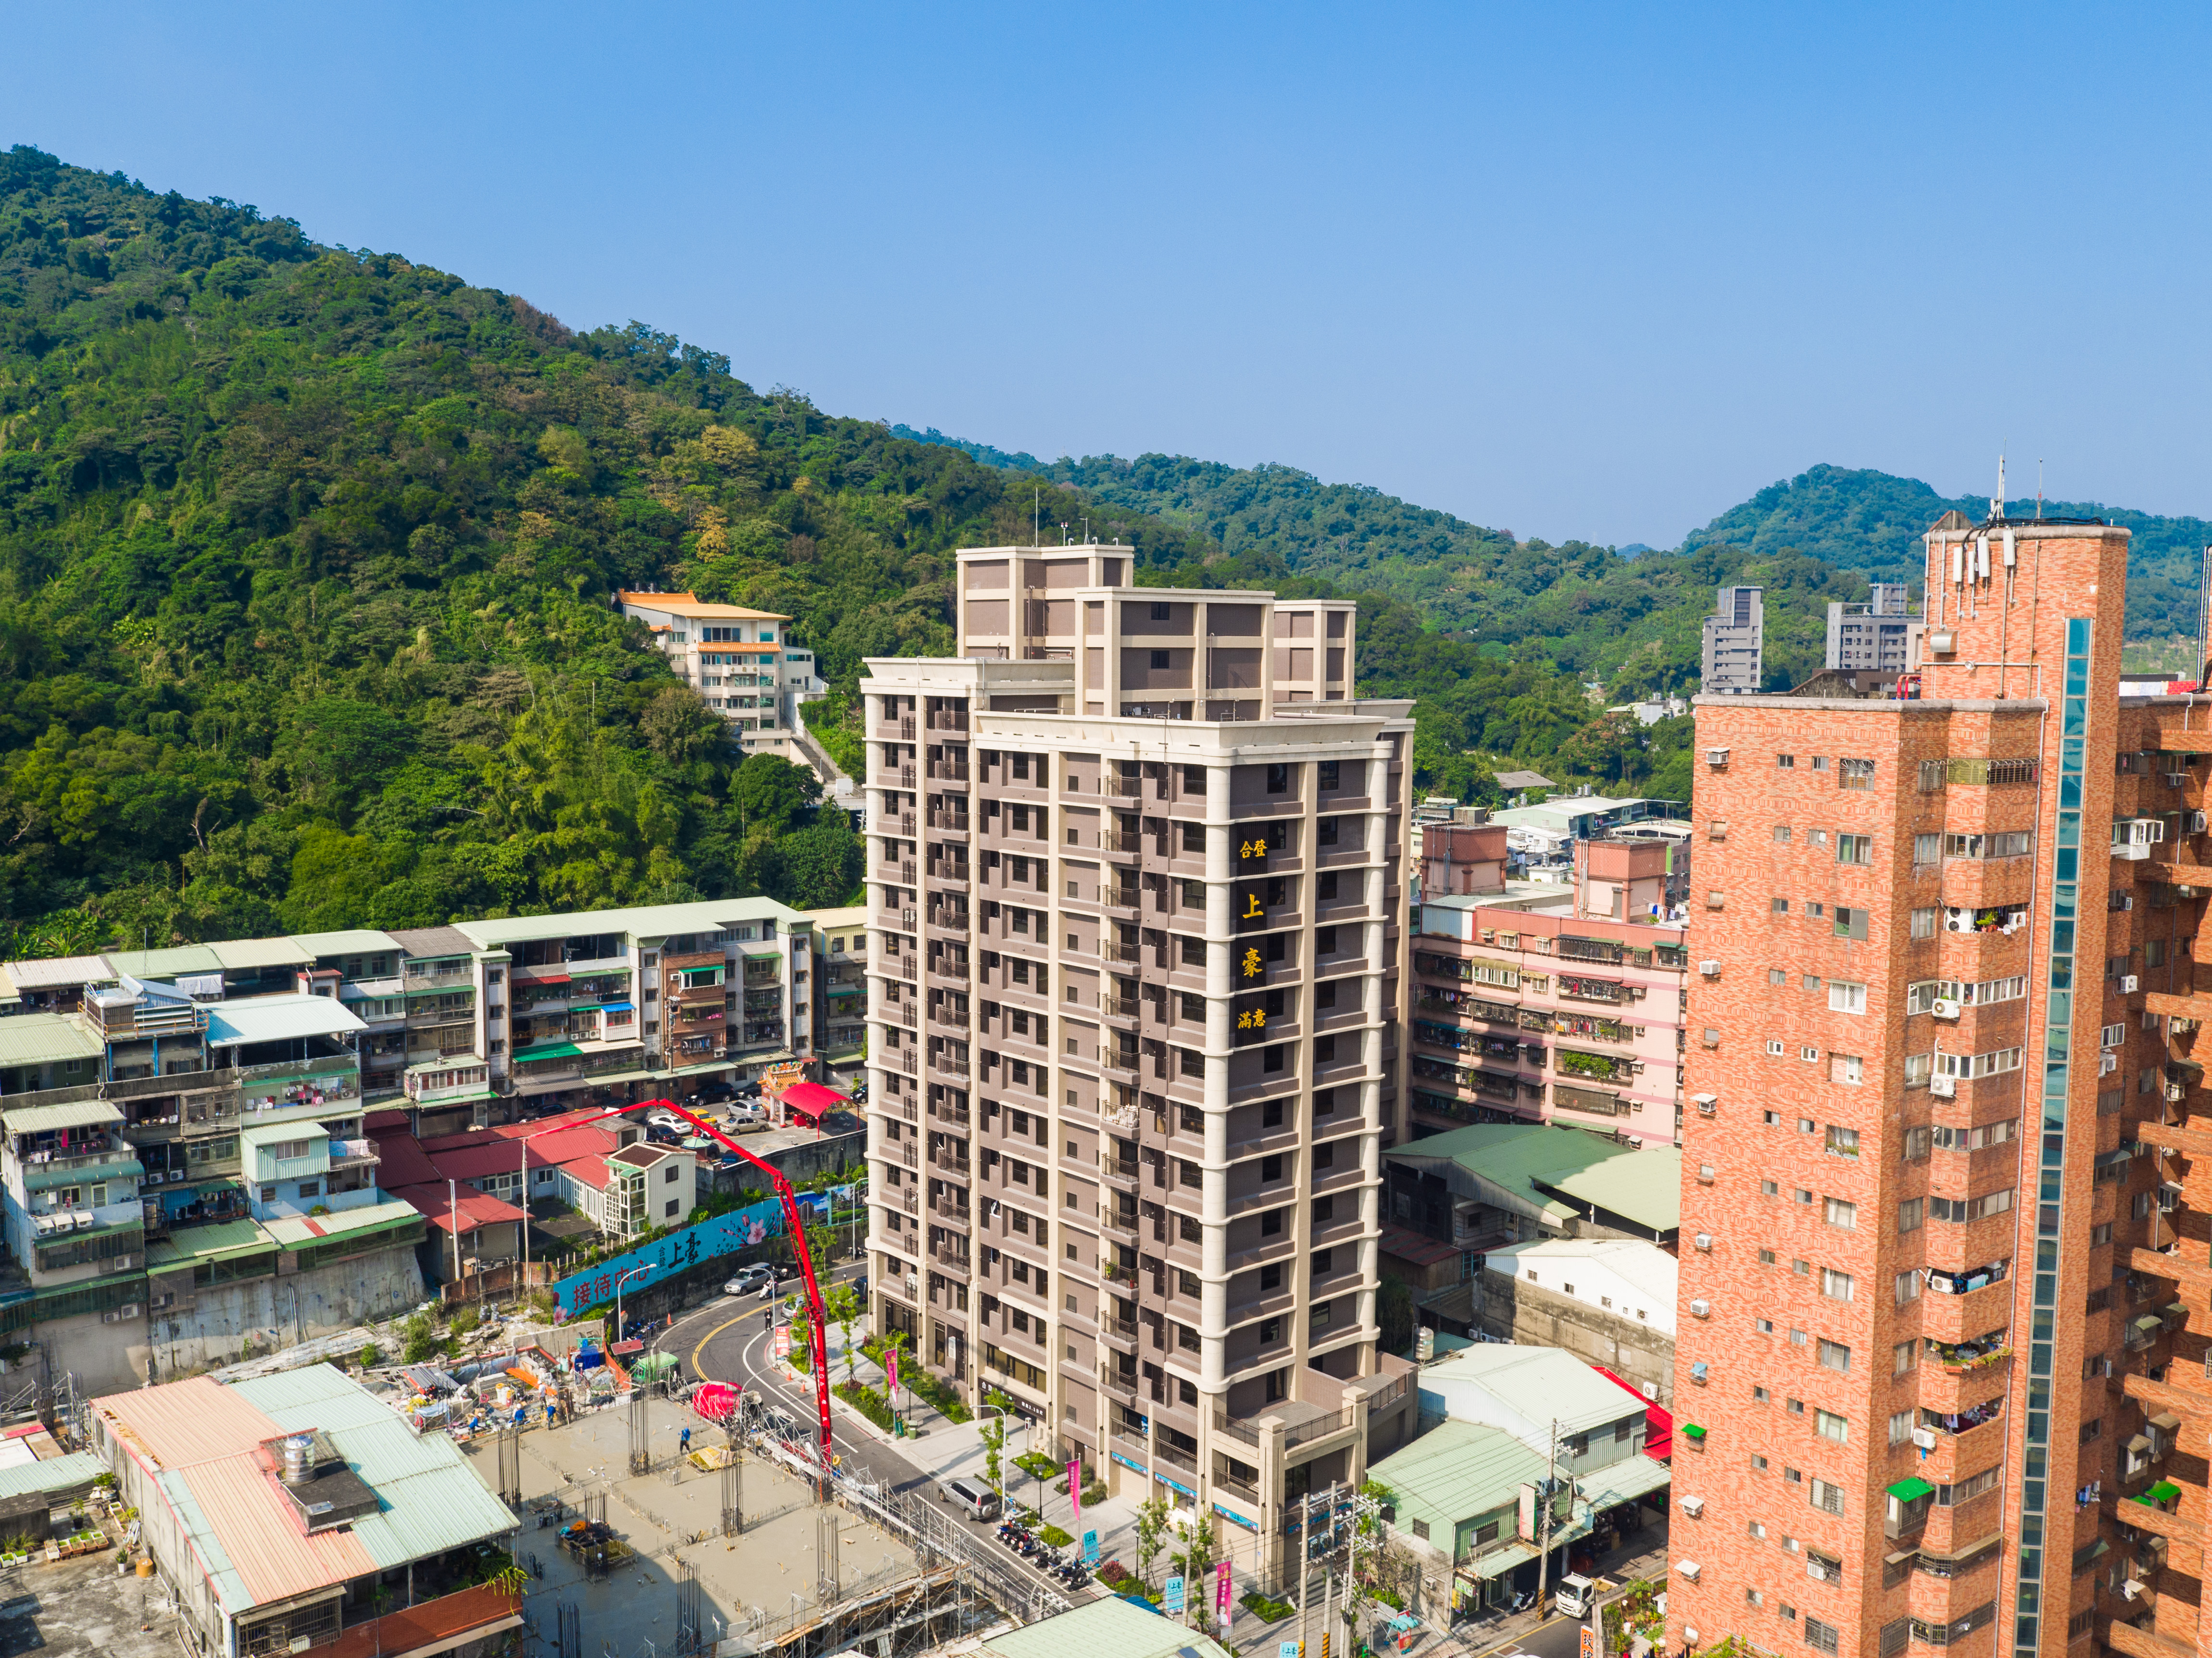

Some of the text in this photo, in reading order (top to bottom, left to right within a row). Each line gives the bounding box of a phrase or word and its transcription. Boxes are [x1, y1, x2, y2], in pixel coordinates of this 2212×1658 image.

[1238, 1008, 1266, 1029] 滿意
[573, 1259, 650, 1311] 接待中心
